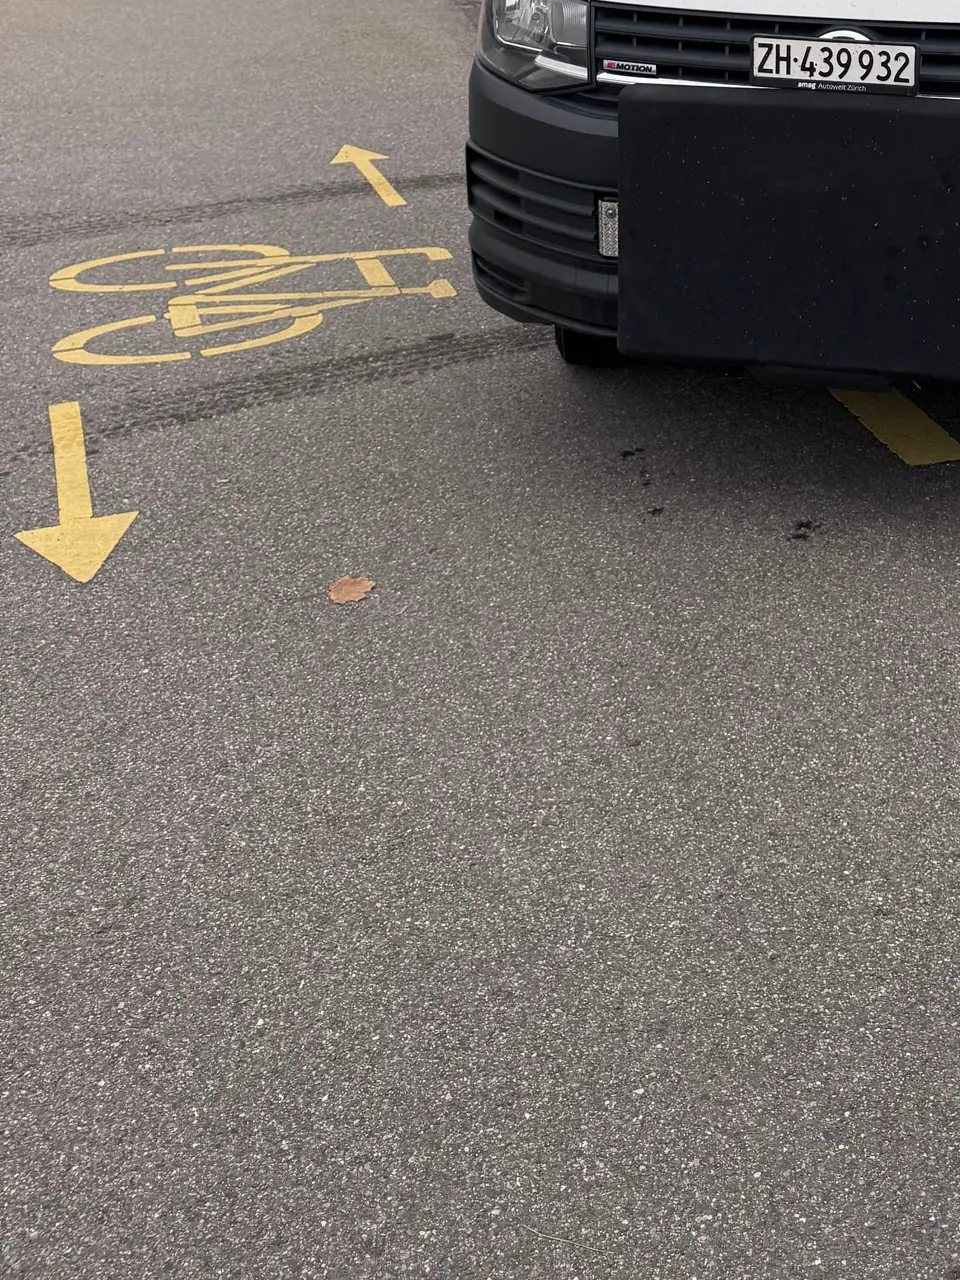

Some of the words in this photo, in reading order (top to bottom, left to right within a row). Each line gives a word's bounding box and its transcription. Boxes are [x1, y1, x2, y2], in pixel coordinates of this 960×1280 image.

[797, 82, 816, 90] amag
[817, 83, 846, 91] Autowelt
[847, 84, 867, 92] Zürich
